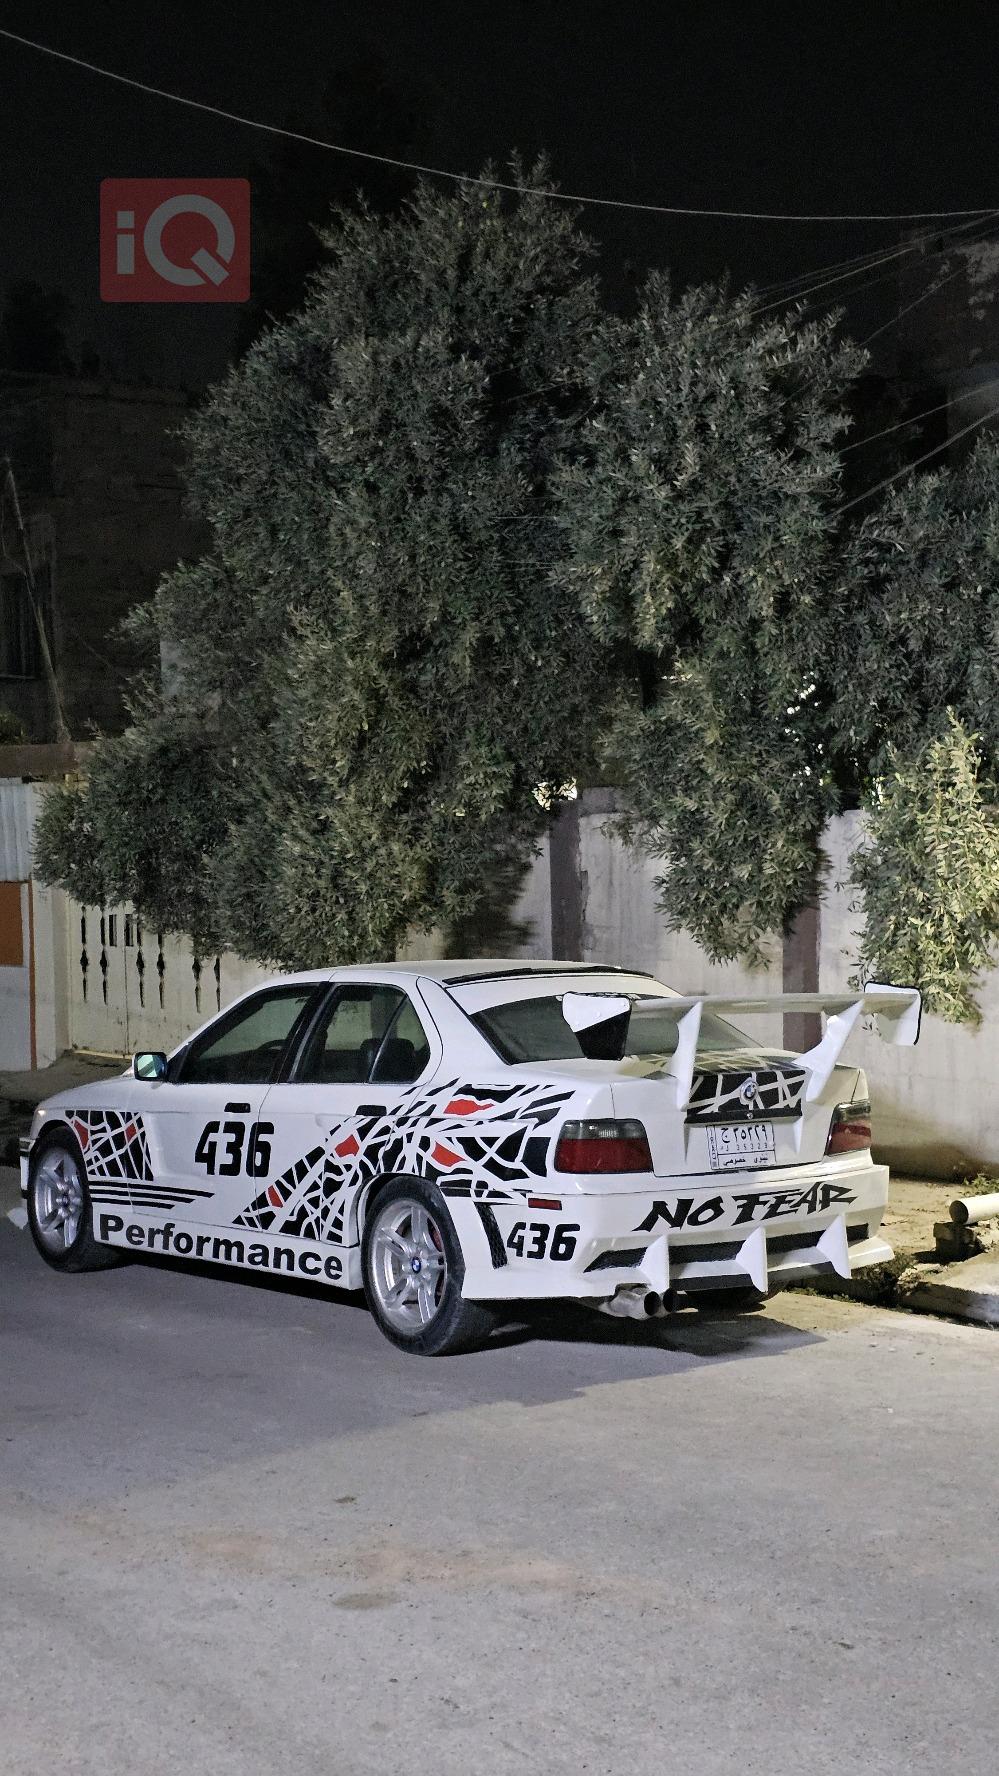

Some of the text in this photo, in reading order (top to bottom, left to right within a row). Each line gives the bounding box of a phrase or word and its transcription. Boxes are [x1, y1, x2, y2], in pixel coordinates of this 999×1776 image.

[195, 1121, 275, 1177] 436
[632, 1181, 859, 1232] NO FEAR
[100, 1213, 343, 1280] Performance
[507, 1222, 580, 1261] 436
